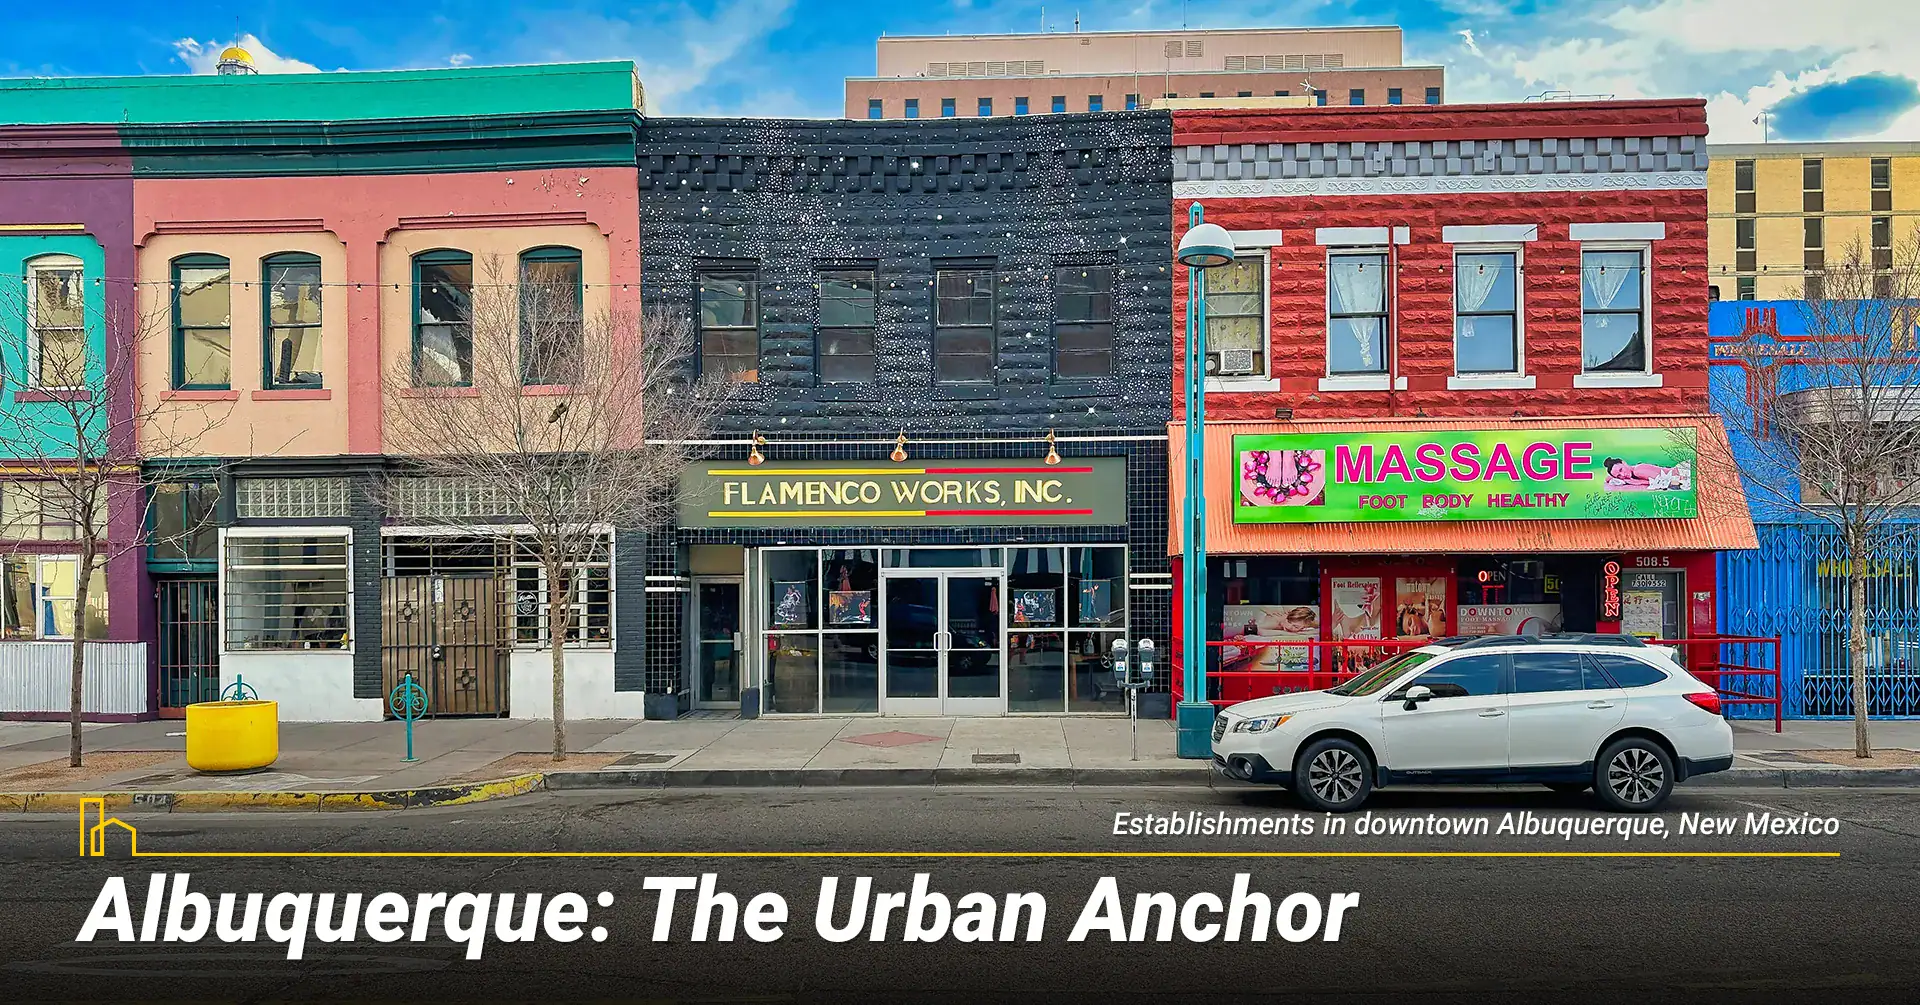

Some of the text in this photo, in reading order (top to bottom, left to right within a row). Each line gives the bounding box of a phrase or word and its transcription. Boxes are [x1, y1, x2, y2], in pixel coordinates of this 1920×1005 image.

[1335, 442, 1594, 483] MASSAGE
[723, 479, 1073, 507] FLAMENCO WORKS, INC.
[1358, 495, 1409, 510] FOOT
[1422, 493, 1473, 509] BODY
[1487, 493, 1569, 508] HEALTHY
[1636, 556, 1670, 567] 508.5
[1818, 559, 1912, 578] WHOESALE
[1478, 570, 1506, 582] OPEN
[1333, 581, 1346, 589] Foot
[1603, 561, 1620, 617] OPEN
[1460, 607, 1532, 617] DOWNTOWN
